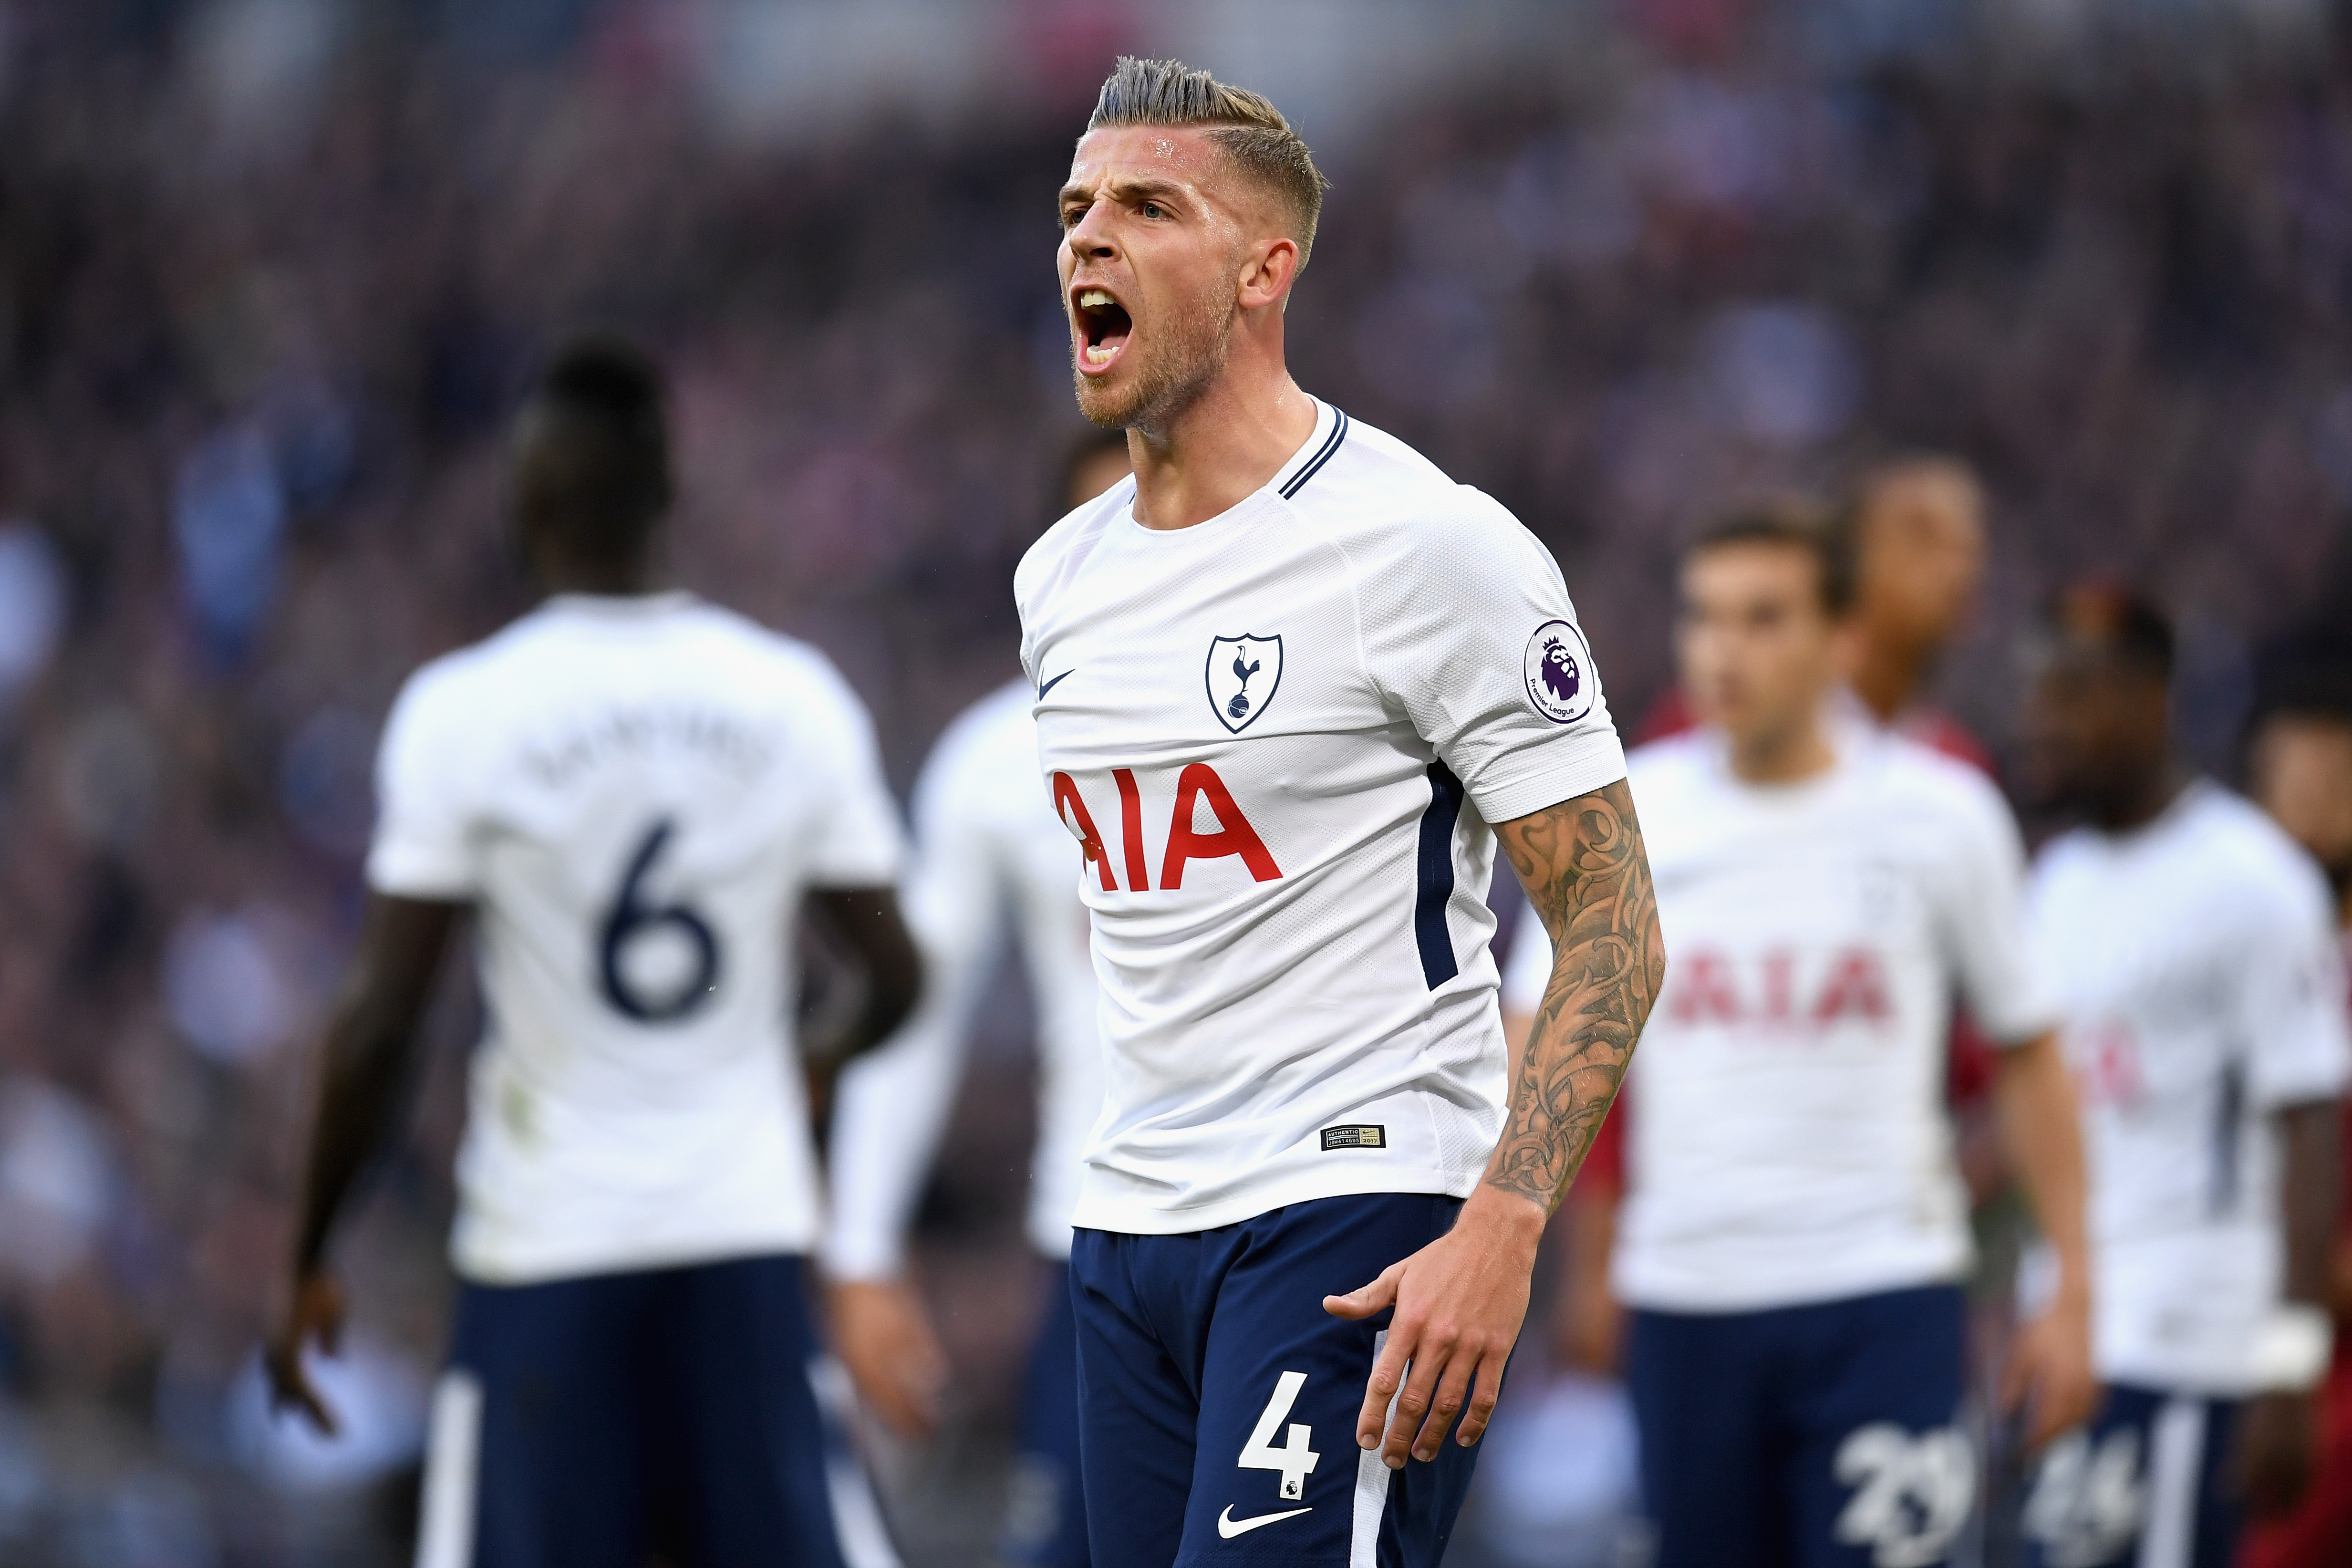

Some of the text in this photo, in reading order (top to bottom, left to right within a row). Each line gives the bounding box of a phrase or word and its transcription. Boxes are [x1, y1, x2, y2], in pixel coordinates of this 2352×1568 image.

[1530, 678, 1574, 717] Premier League
[1053, 763, 1284, 892] AIA
[596, 817, 724, 1027] 6
[1665, 945, 1898, 1028] AIA
[1238, 1371, 1320, 1500] 4
